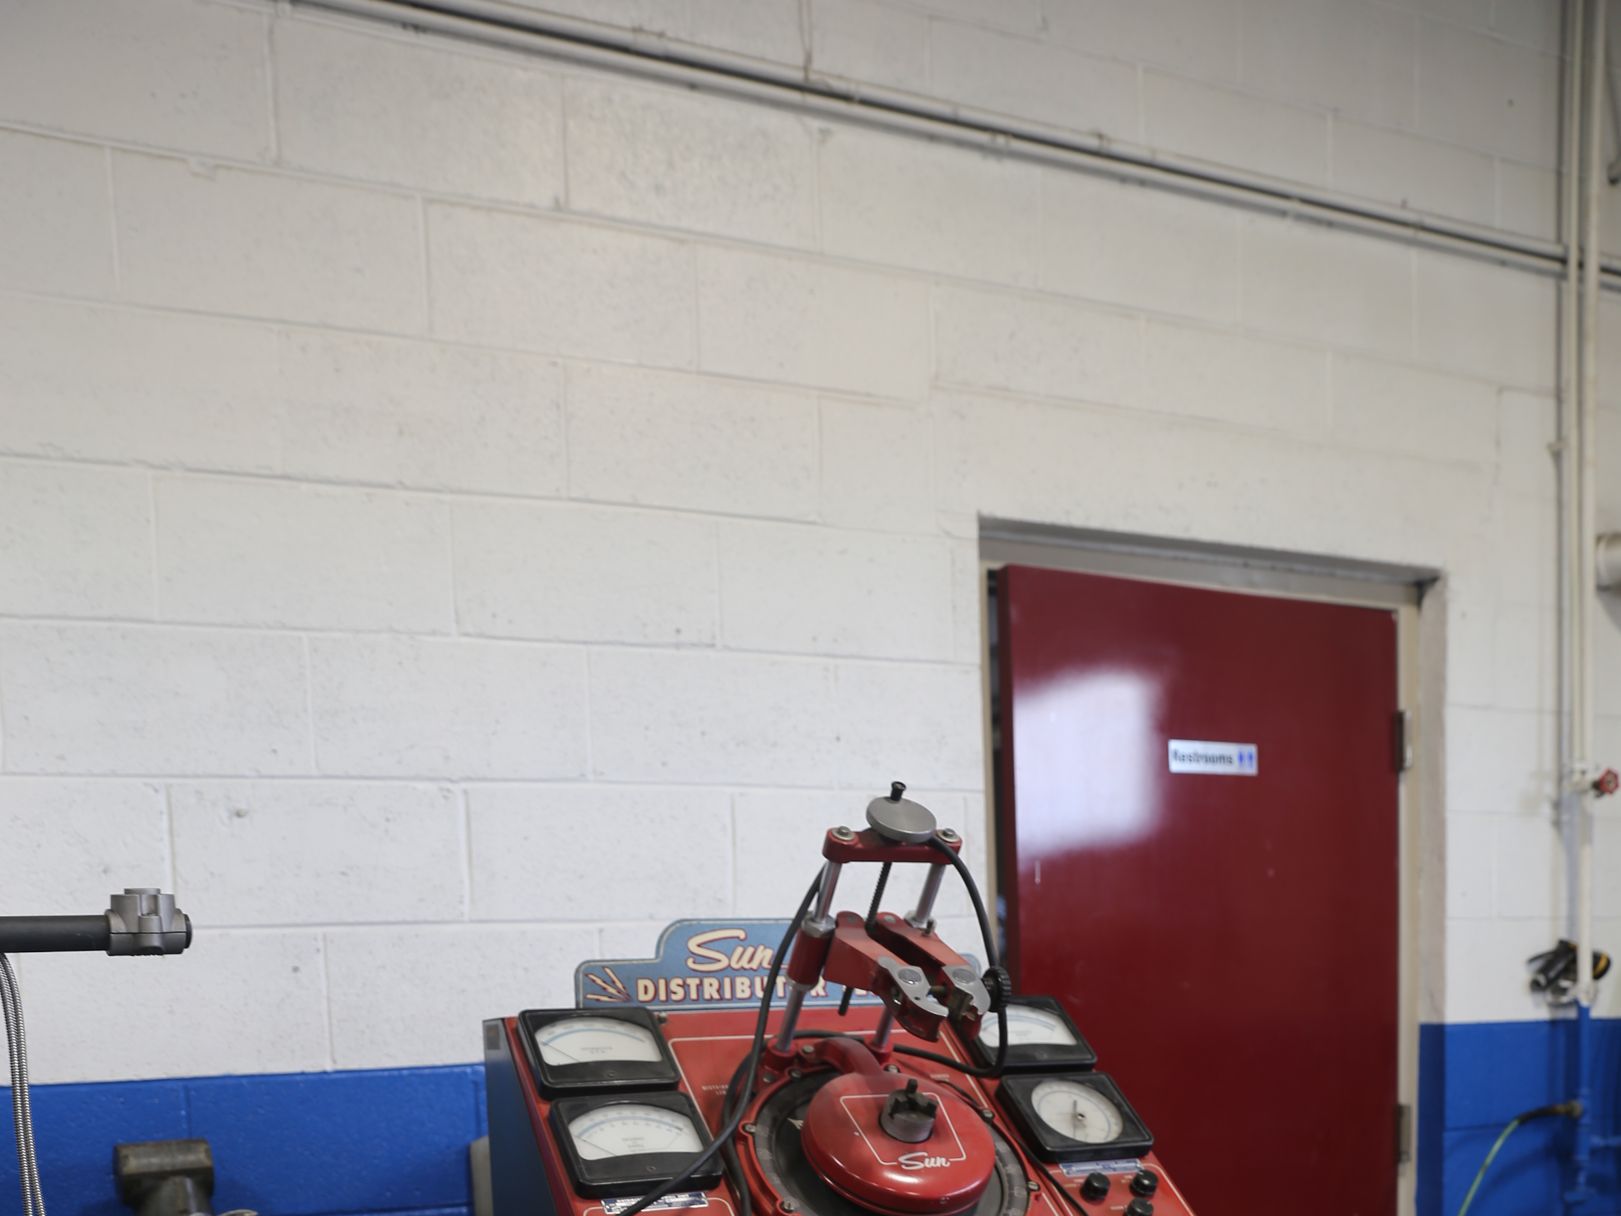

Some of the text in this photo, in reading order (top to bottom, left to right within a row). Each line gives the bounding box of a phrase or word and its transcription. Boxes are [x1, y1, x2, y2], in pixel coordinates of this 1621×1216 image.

[685, 928, 776, 973] Sun
[636, 975, 828, 1003] DISTRIBUTR
[898, 1151, 951, 1171] Sun
